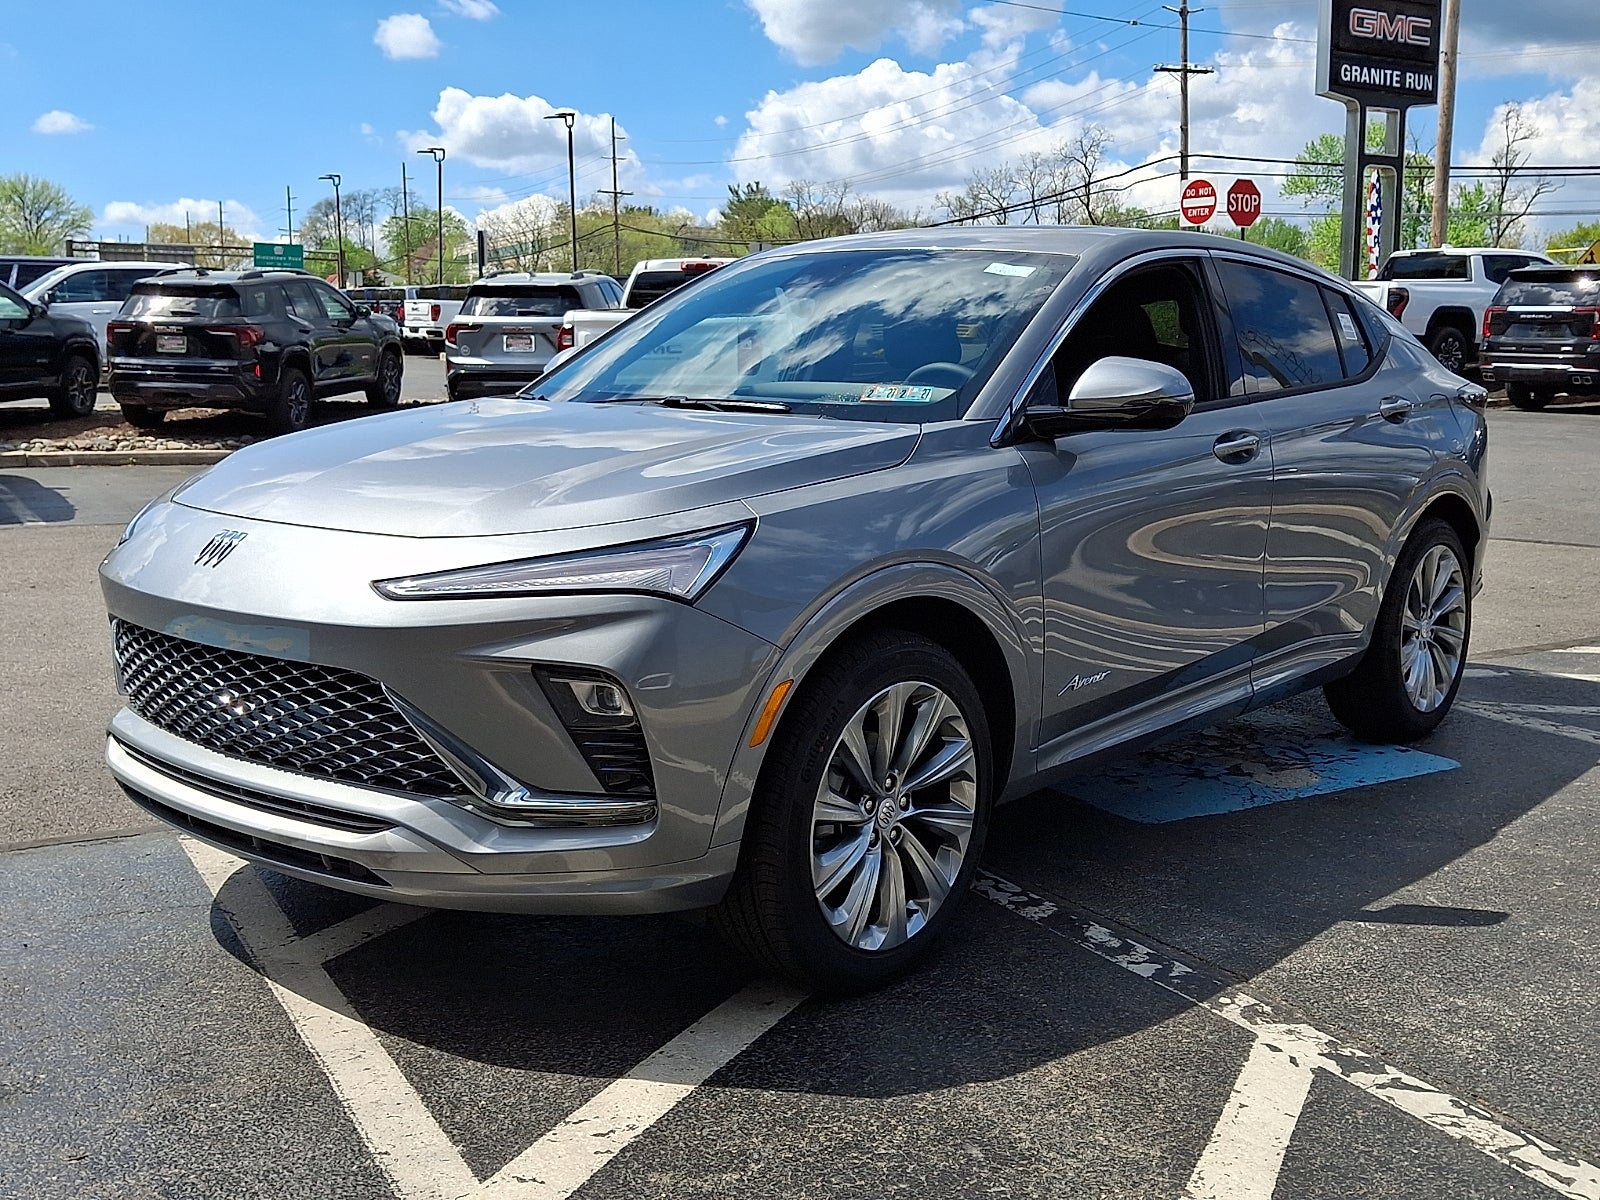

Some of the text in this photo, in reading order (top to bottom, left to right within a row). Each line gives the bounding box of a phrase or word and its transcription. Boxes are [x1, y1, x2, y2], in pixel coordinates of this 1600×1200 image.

[1350, 7, 1432, 46] GMC
[1341, 64, 1433, 91] GRANITE RUN
[1186, 186, 1213, 197] DO NOT
[1229, 193, 1259, 212] STOP
[1187, 207, 1210, 217] ENTER
[1057, 670, 1112, 697] Avenir
